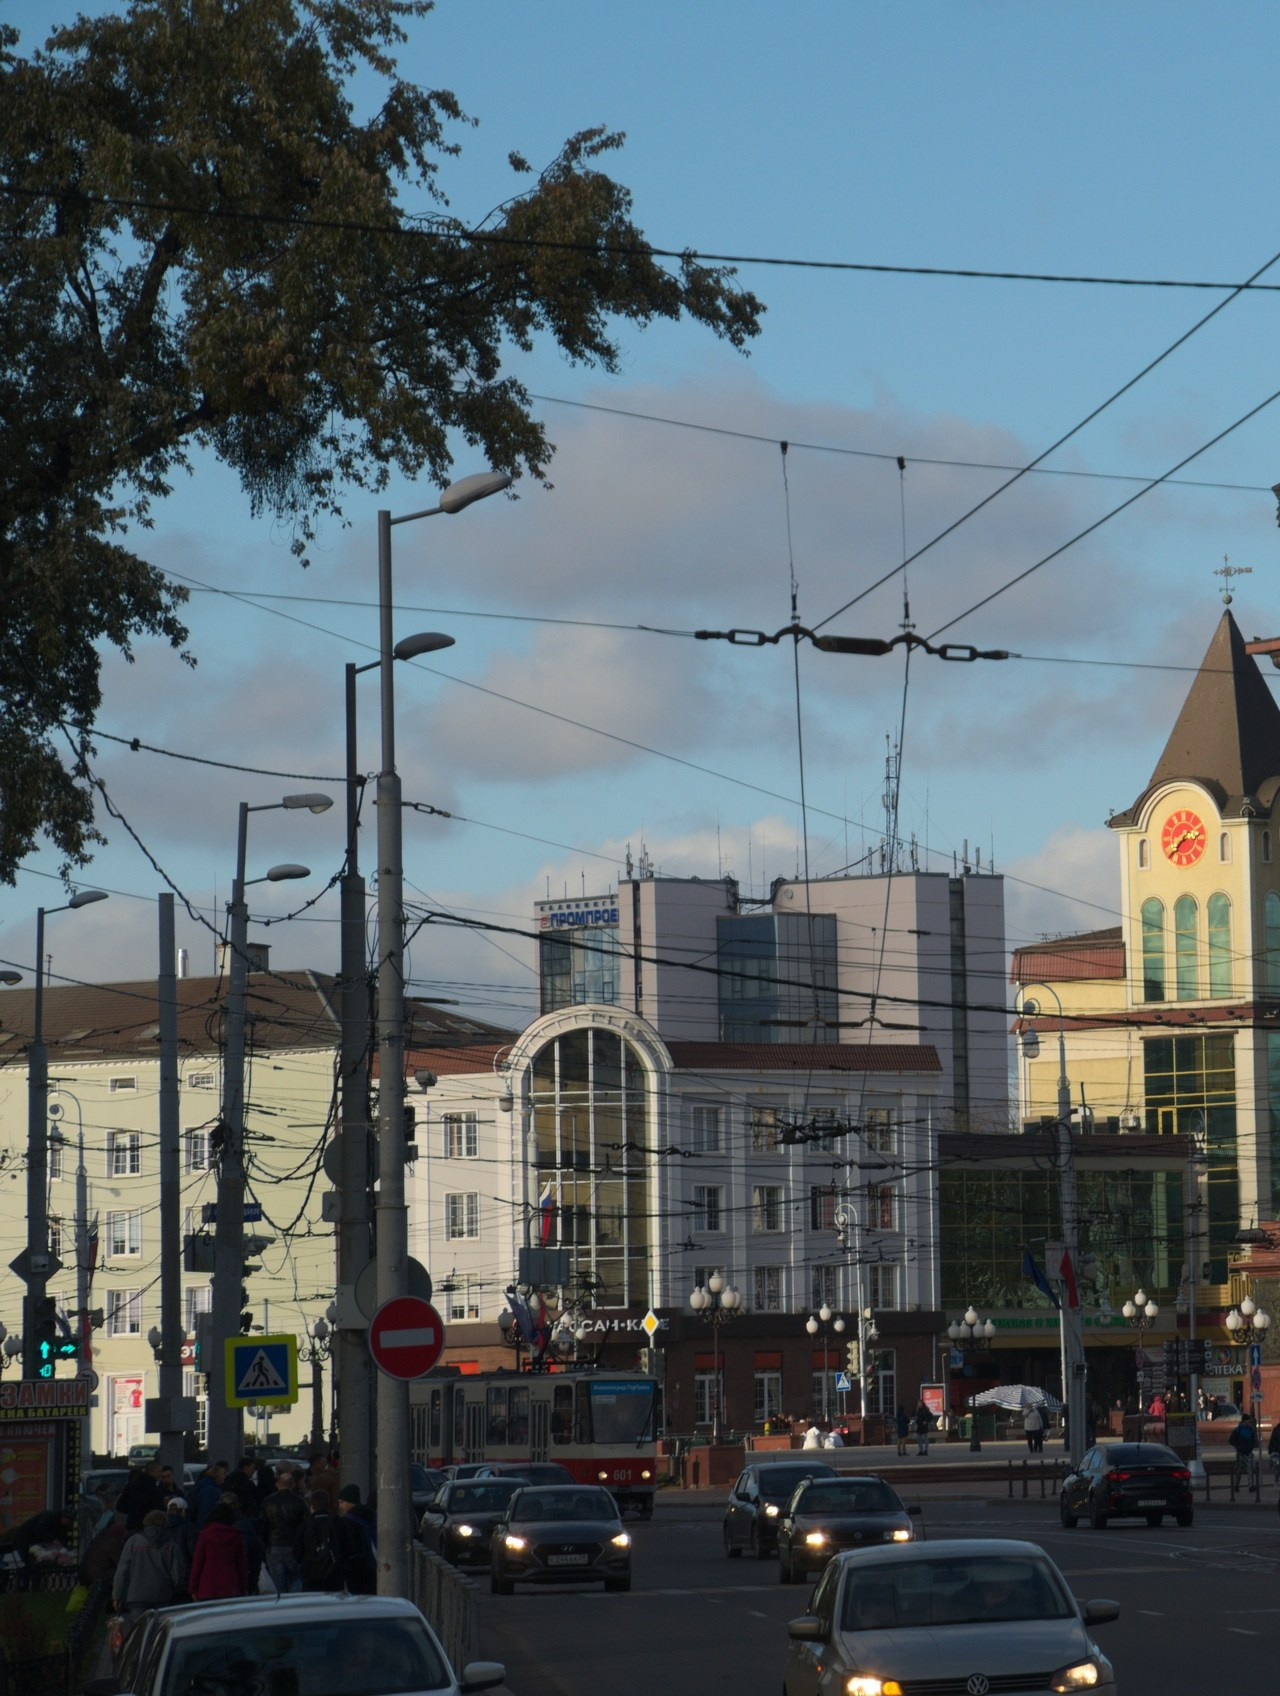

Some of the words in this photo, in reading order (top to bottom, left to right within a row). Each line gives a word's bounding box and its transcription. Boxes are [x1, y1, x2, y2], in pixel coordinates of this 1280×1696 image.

[551, 908, 619, 927] ПРОМПРОЕ
[1208, 1364, 1243, 1375] ПТЕКА
[0, 1382, 88, 1408] ЗАМКИ
[28, 1407, 86, 1417] БАТАРЕЕК
[613, 1469, 632, 1480] 601
